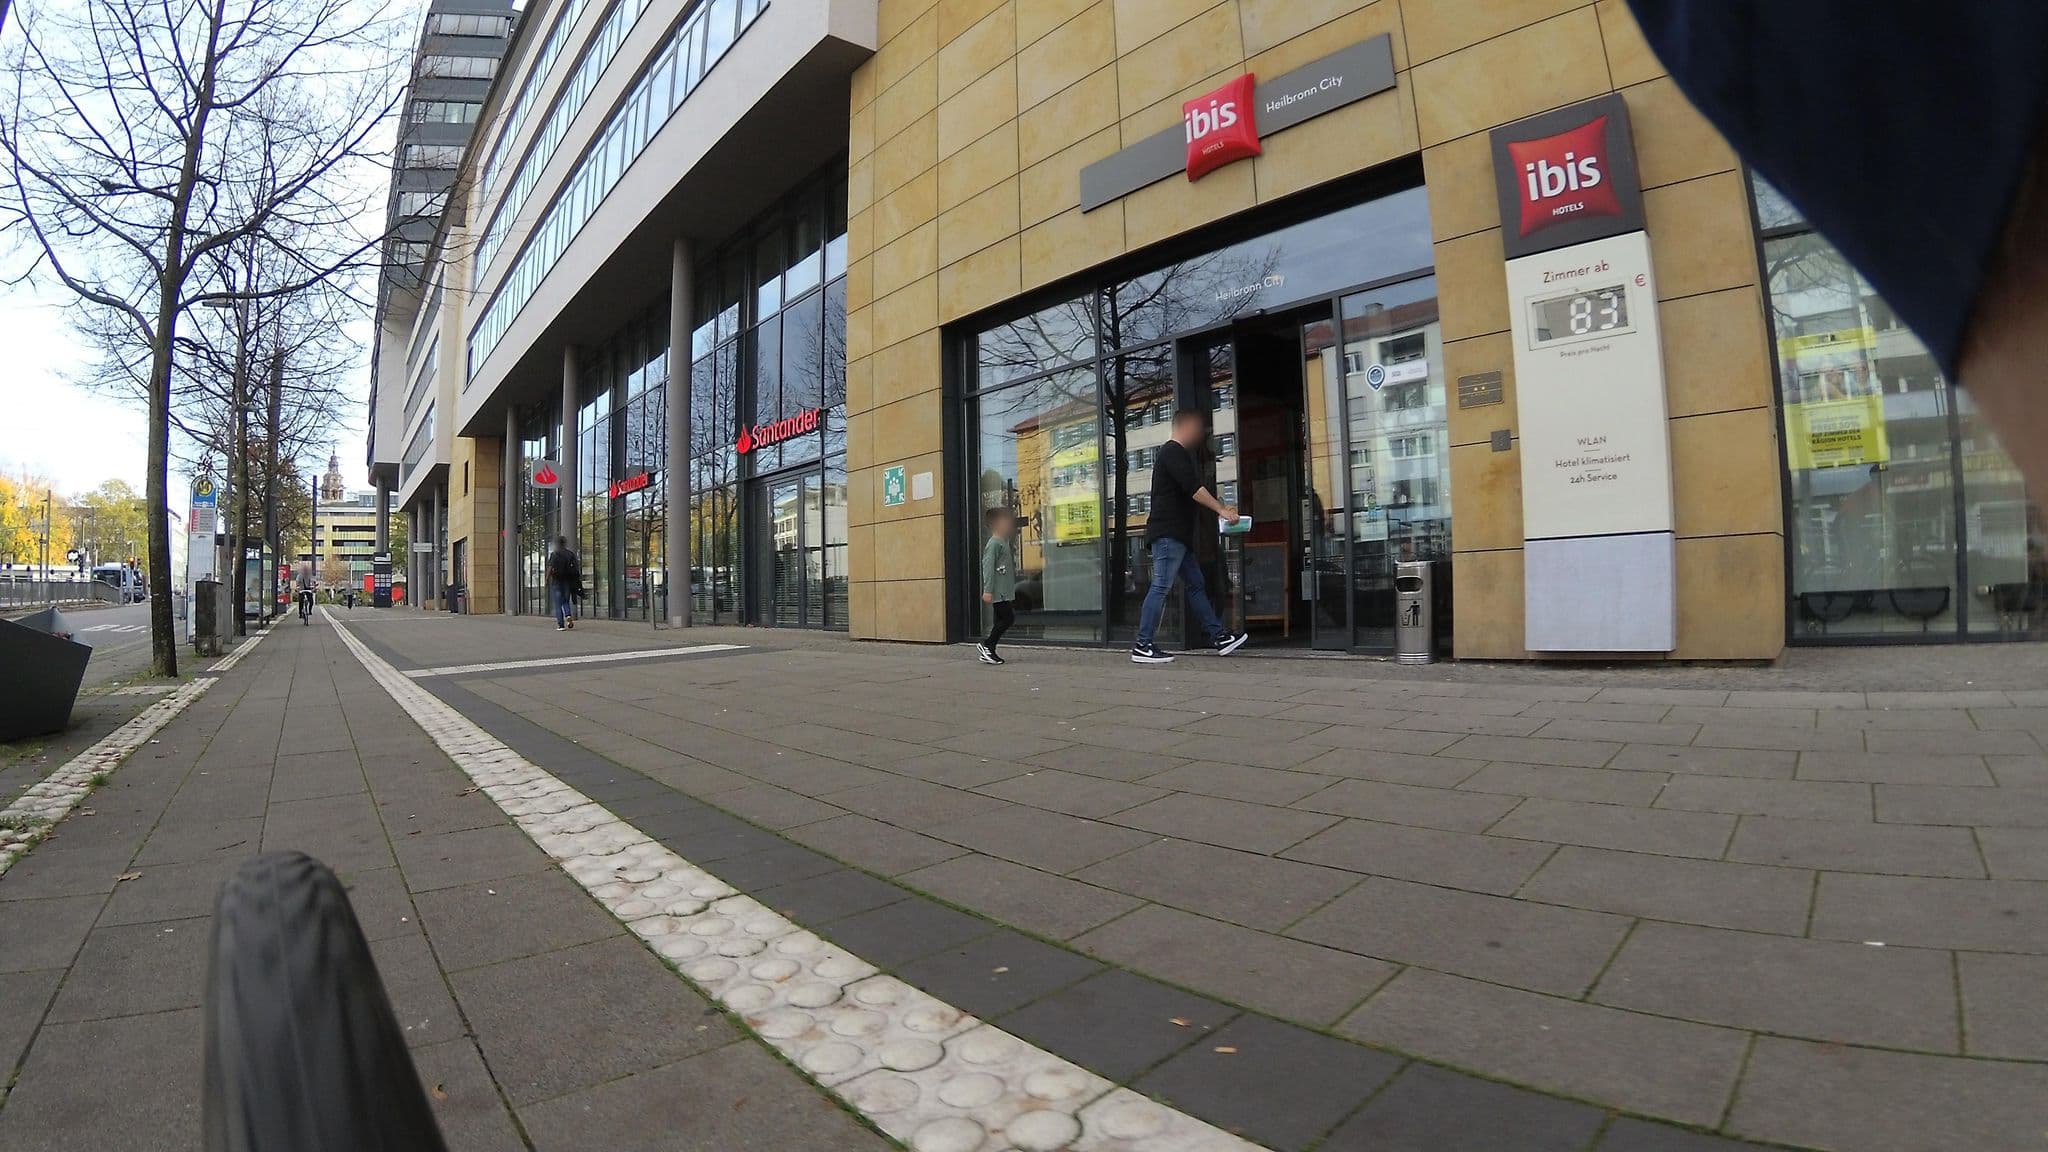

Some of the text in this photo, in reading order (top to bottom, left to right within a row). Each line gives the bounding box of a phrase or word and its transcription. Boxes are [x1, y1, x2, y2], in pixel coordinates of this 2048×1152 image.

[1266, 75, 1344, 113] Heilbronn City
[1185, 99, 1238, 144] ibis
[1202, 141, 1225, 155] HOTELS
[1526, 151, 1601, 201] ibis
[1552, 202, 1585, 216] HOTELS
[1543, 259, 1610, 283] Zimmer ab
[1634, 273, 1646, 287] €
[1215, 275, 1285, 302] Heilbronn City
[1570, 291, 1618, 335] 83
[752, 407, 820, 450] Santander
[1577, 435, 1607, 446] WLAN
[1555, 454, 1631, 468] Hotel klimatisiert
[617, 471, 648, 495] Santander
[1570, 473, 1618, 484] 24h Service
